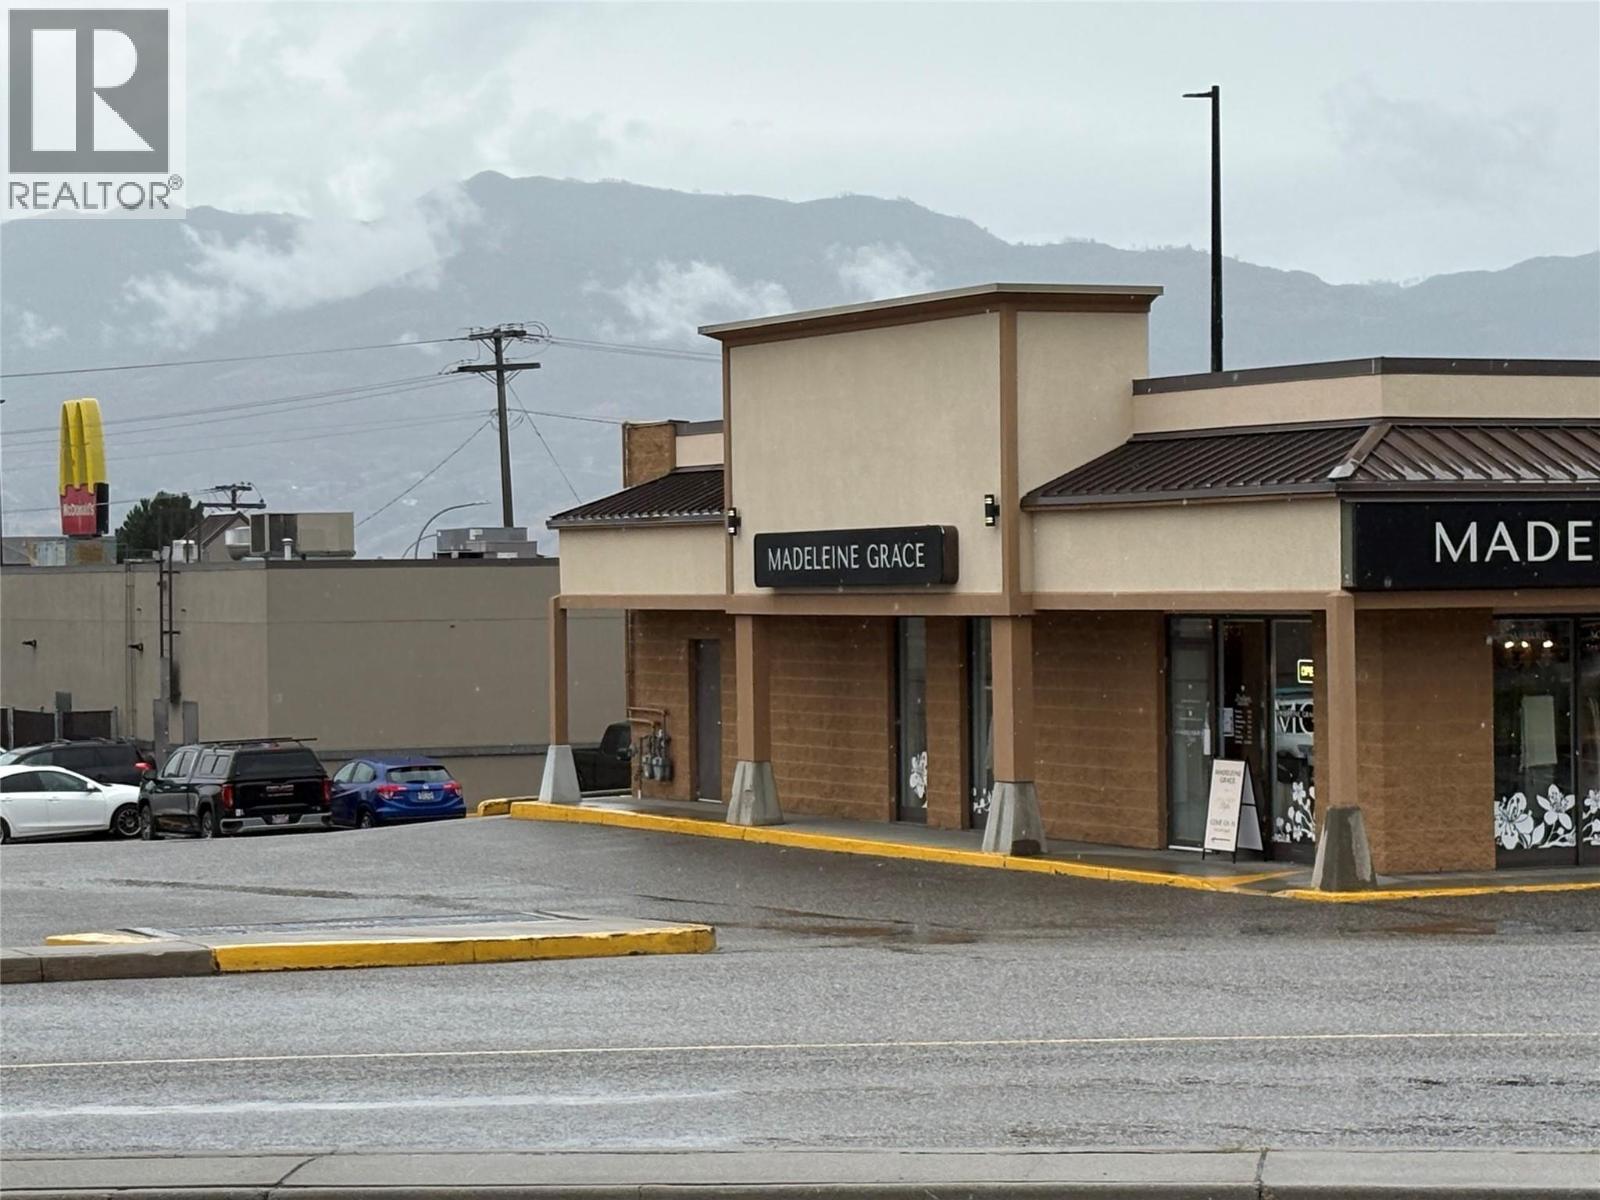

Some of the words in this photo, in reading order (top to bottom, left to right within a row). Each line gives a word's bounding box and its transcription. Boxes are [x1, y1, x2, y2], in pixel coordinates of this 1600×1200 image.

[768, 544, 860, 571] MADELEINE
[866, 542, 926, 569] GRACE
[1301, 665, 1314, 677] OPE
